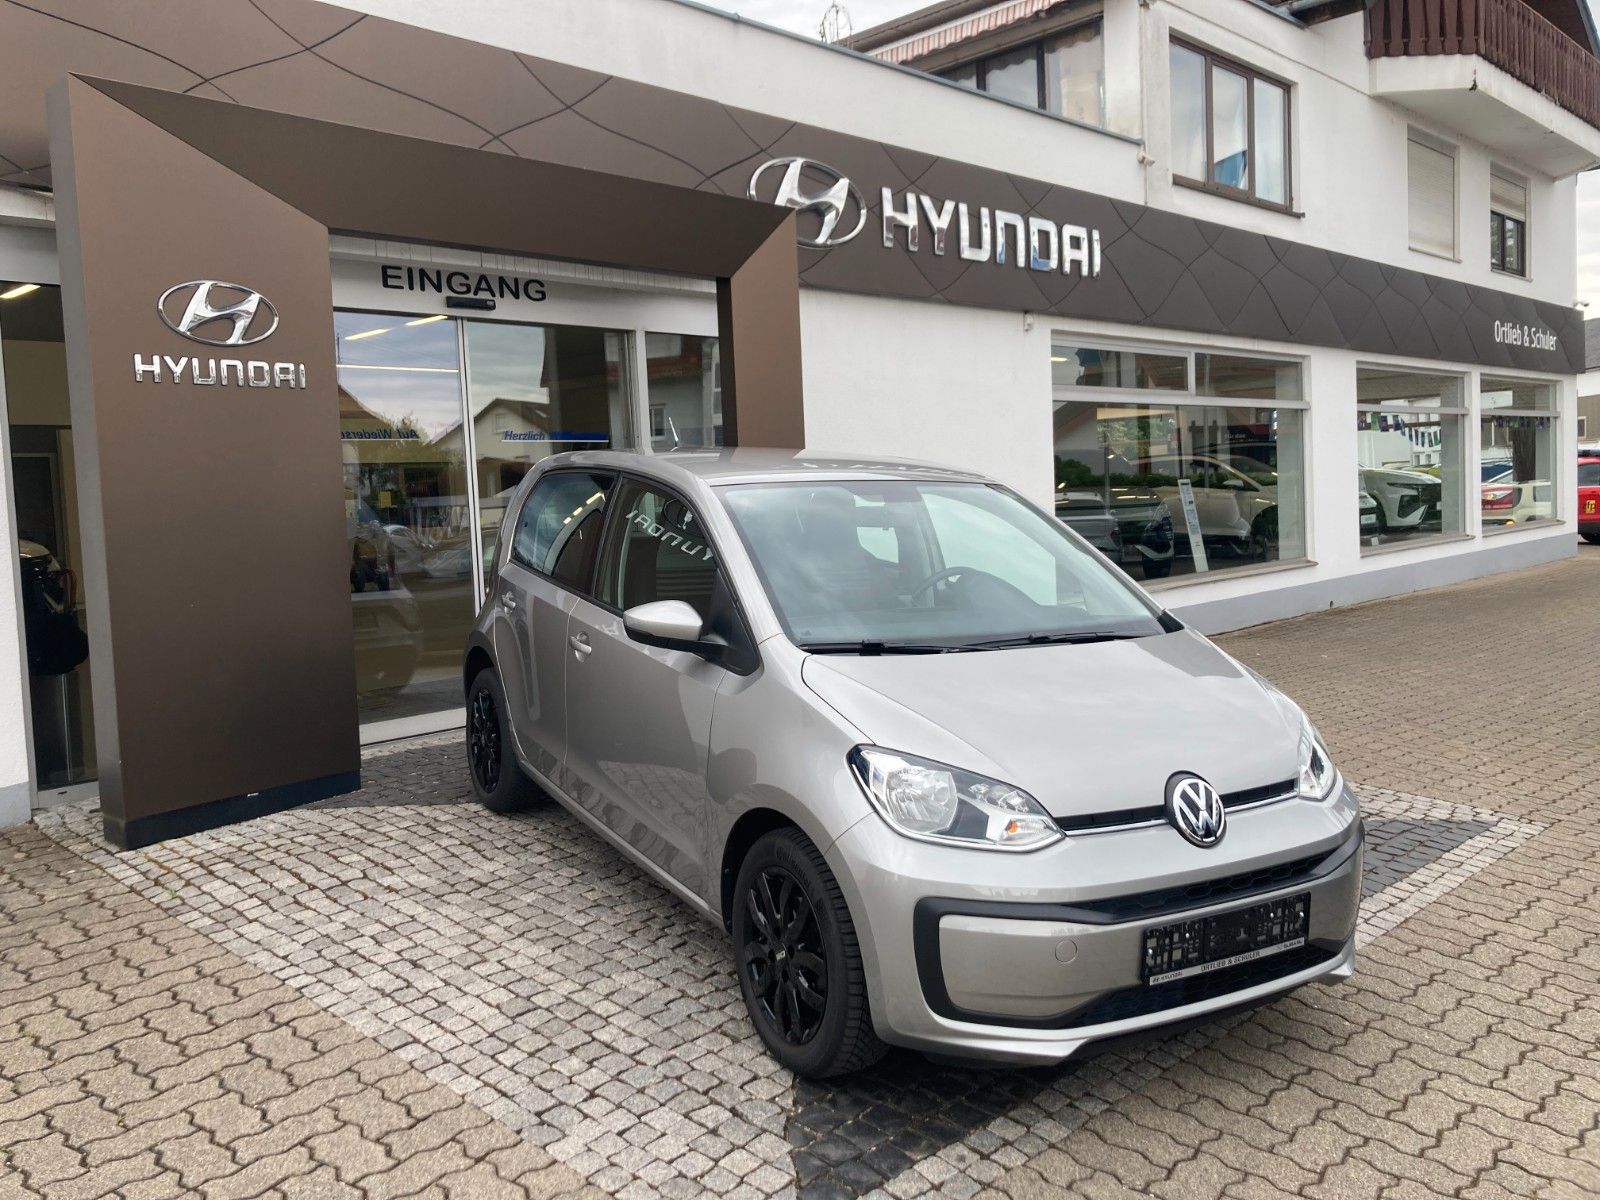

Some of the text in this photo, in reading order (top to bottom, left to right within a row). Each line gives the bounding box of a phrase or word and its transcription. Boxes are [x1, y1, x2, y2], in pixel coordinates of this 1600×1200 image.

[880, 186, 1102, 279] HYUNDAI
[381, 265, 548, 302] EINGANG
[1494, 320, 1557, 351] Ortlieb & Schuler
[133, 353, 307, 390] HYUNDAI
[504, 430, 545, 441] Herzlich
